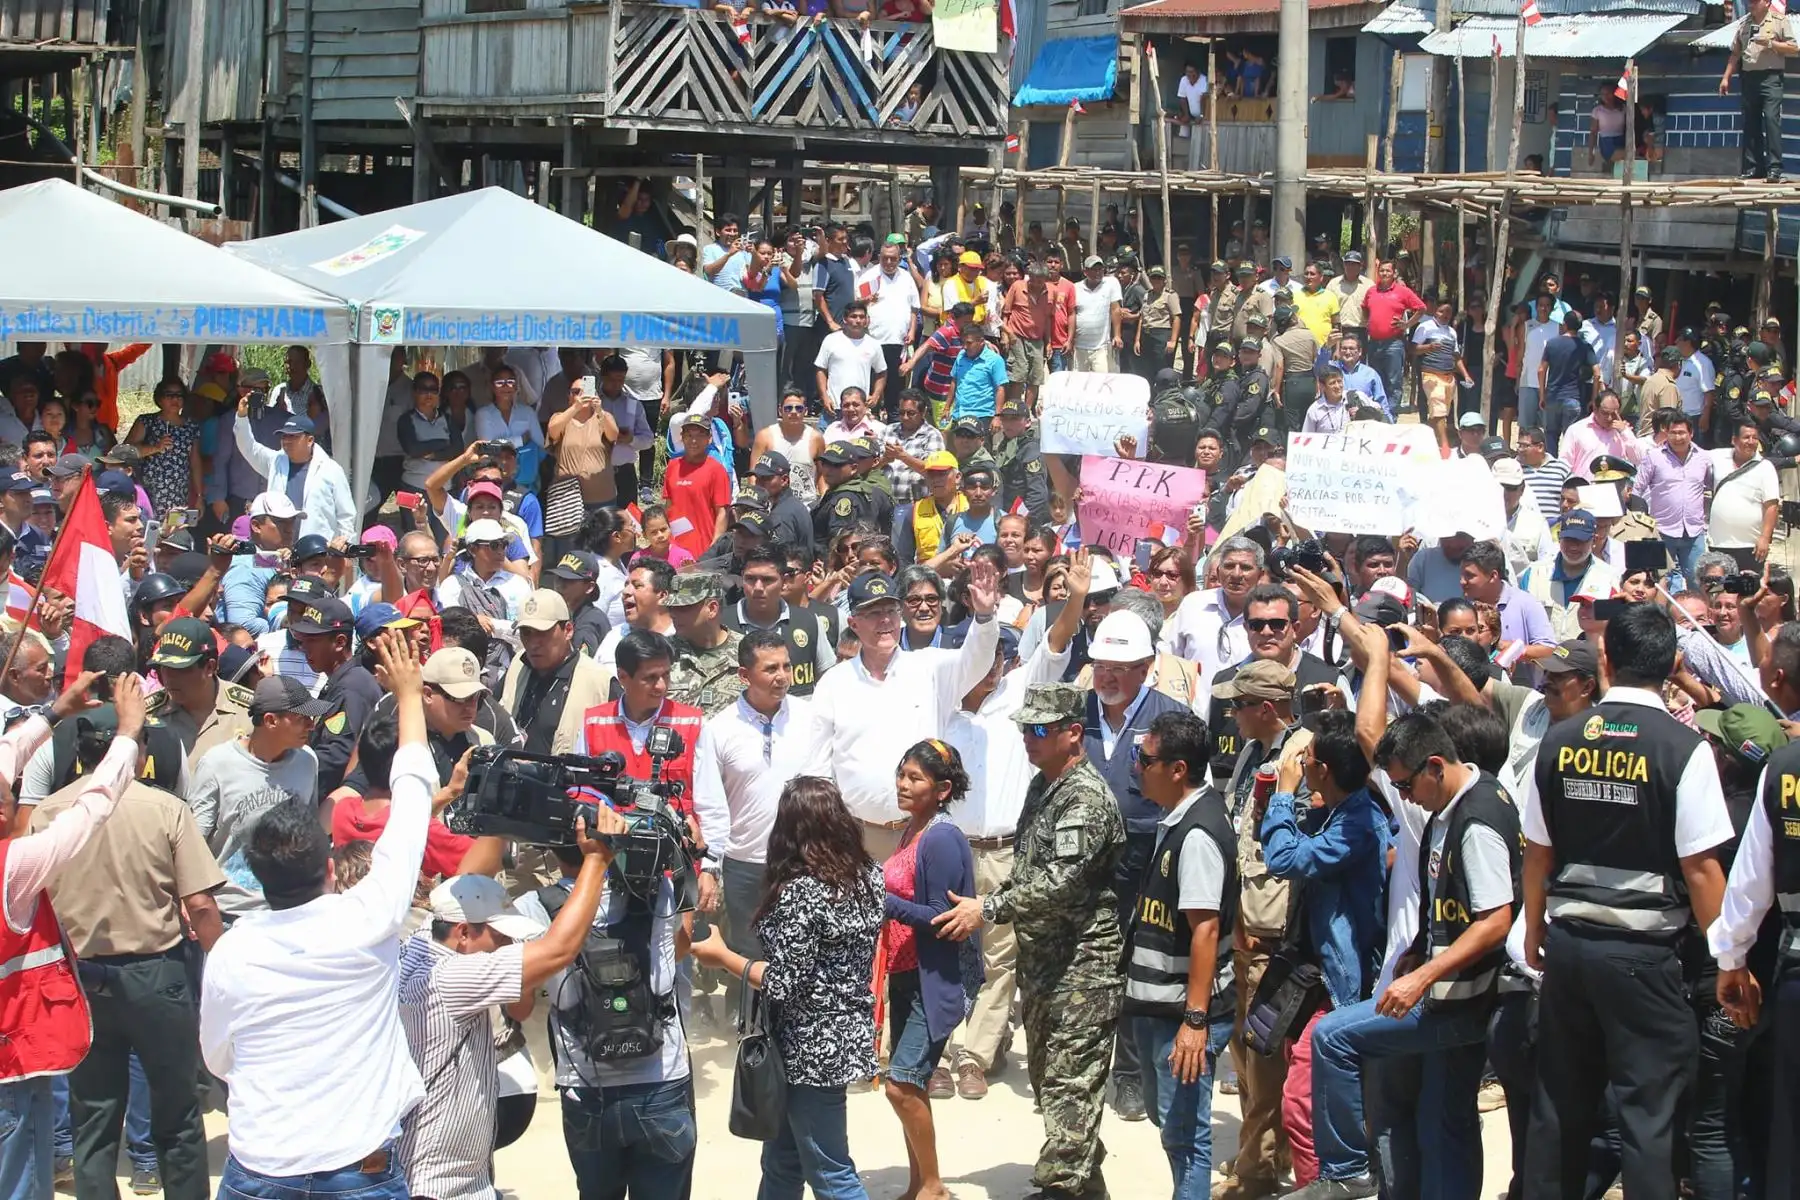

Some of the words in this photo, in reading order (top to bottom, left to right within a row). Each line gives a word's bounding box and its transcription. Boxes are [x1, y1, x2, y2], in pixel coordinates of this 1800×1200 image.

[404, 311, 517, 344] Municipalidad
[523, 314, 587, 341] Distrital
[590, 314, 612, 341] de
[619, 312, 741, 345] PUNCHANA
[1052, 414, 1129, 441] PUENTE
[1321, 434, 1373, 455] PPK
[1315, 474, 1333, 488] TU
[1340, 477, 1385, 492] CASA
[1287, 488, 1339, 501] GRACIAS
[1345, 492, 1366, 504] POR
[1373, 495, 1391, 506] TU
[1603, 722, 1638, 734] POLICIA
[1566, 781, 1600, 798] SEGURIDAD
[1602, 784, 1612, 800] DE
[1613, 785, 1635, 803] ESTADO
